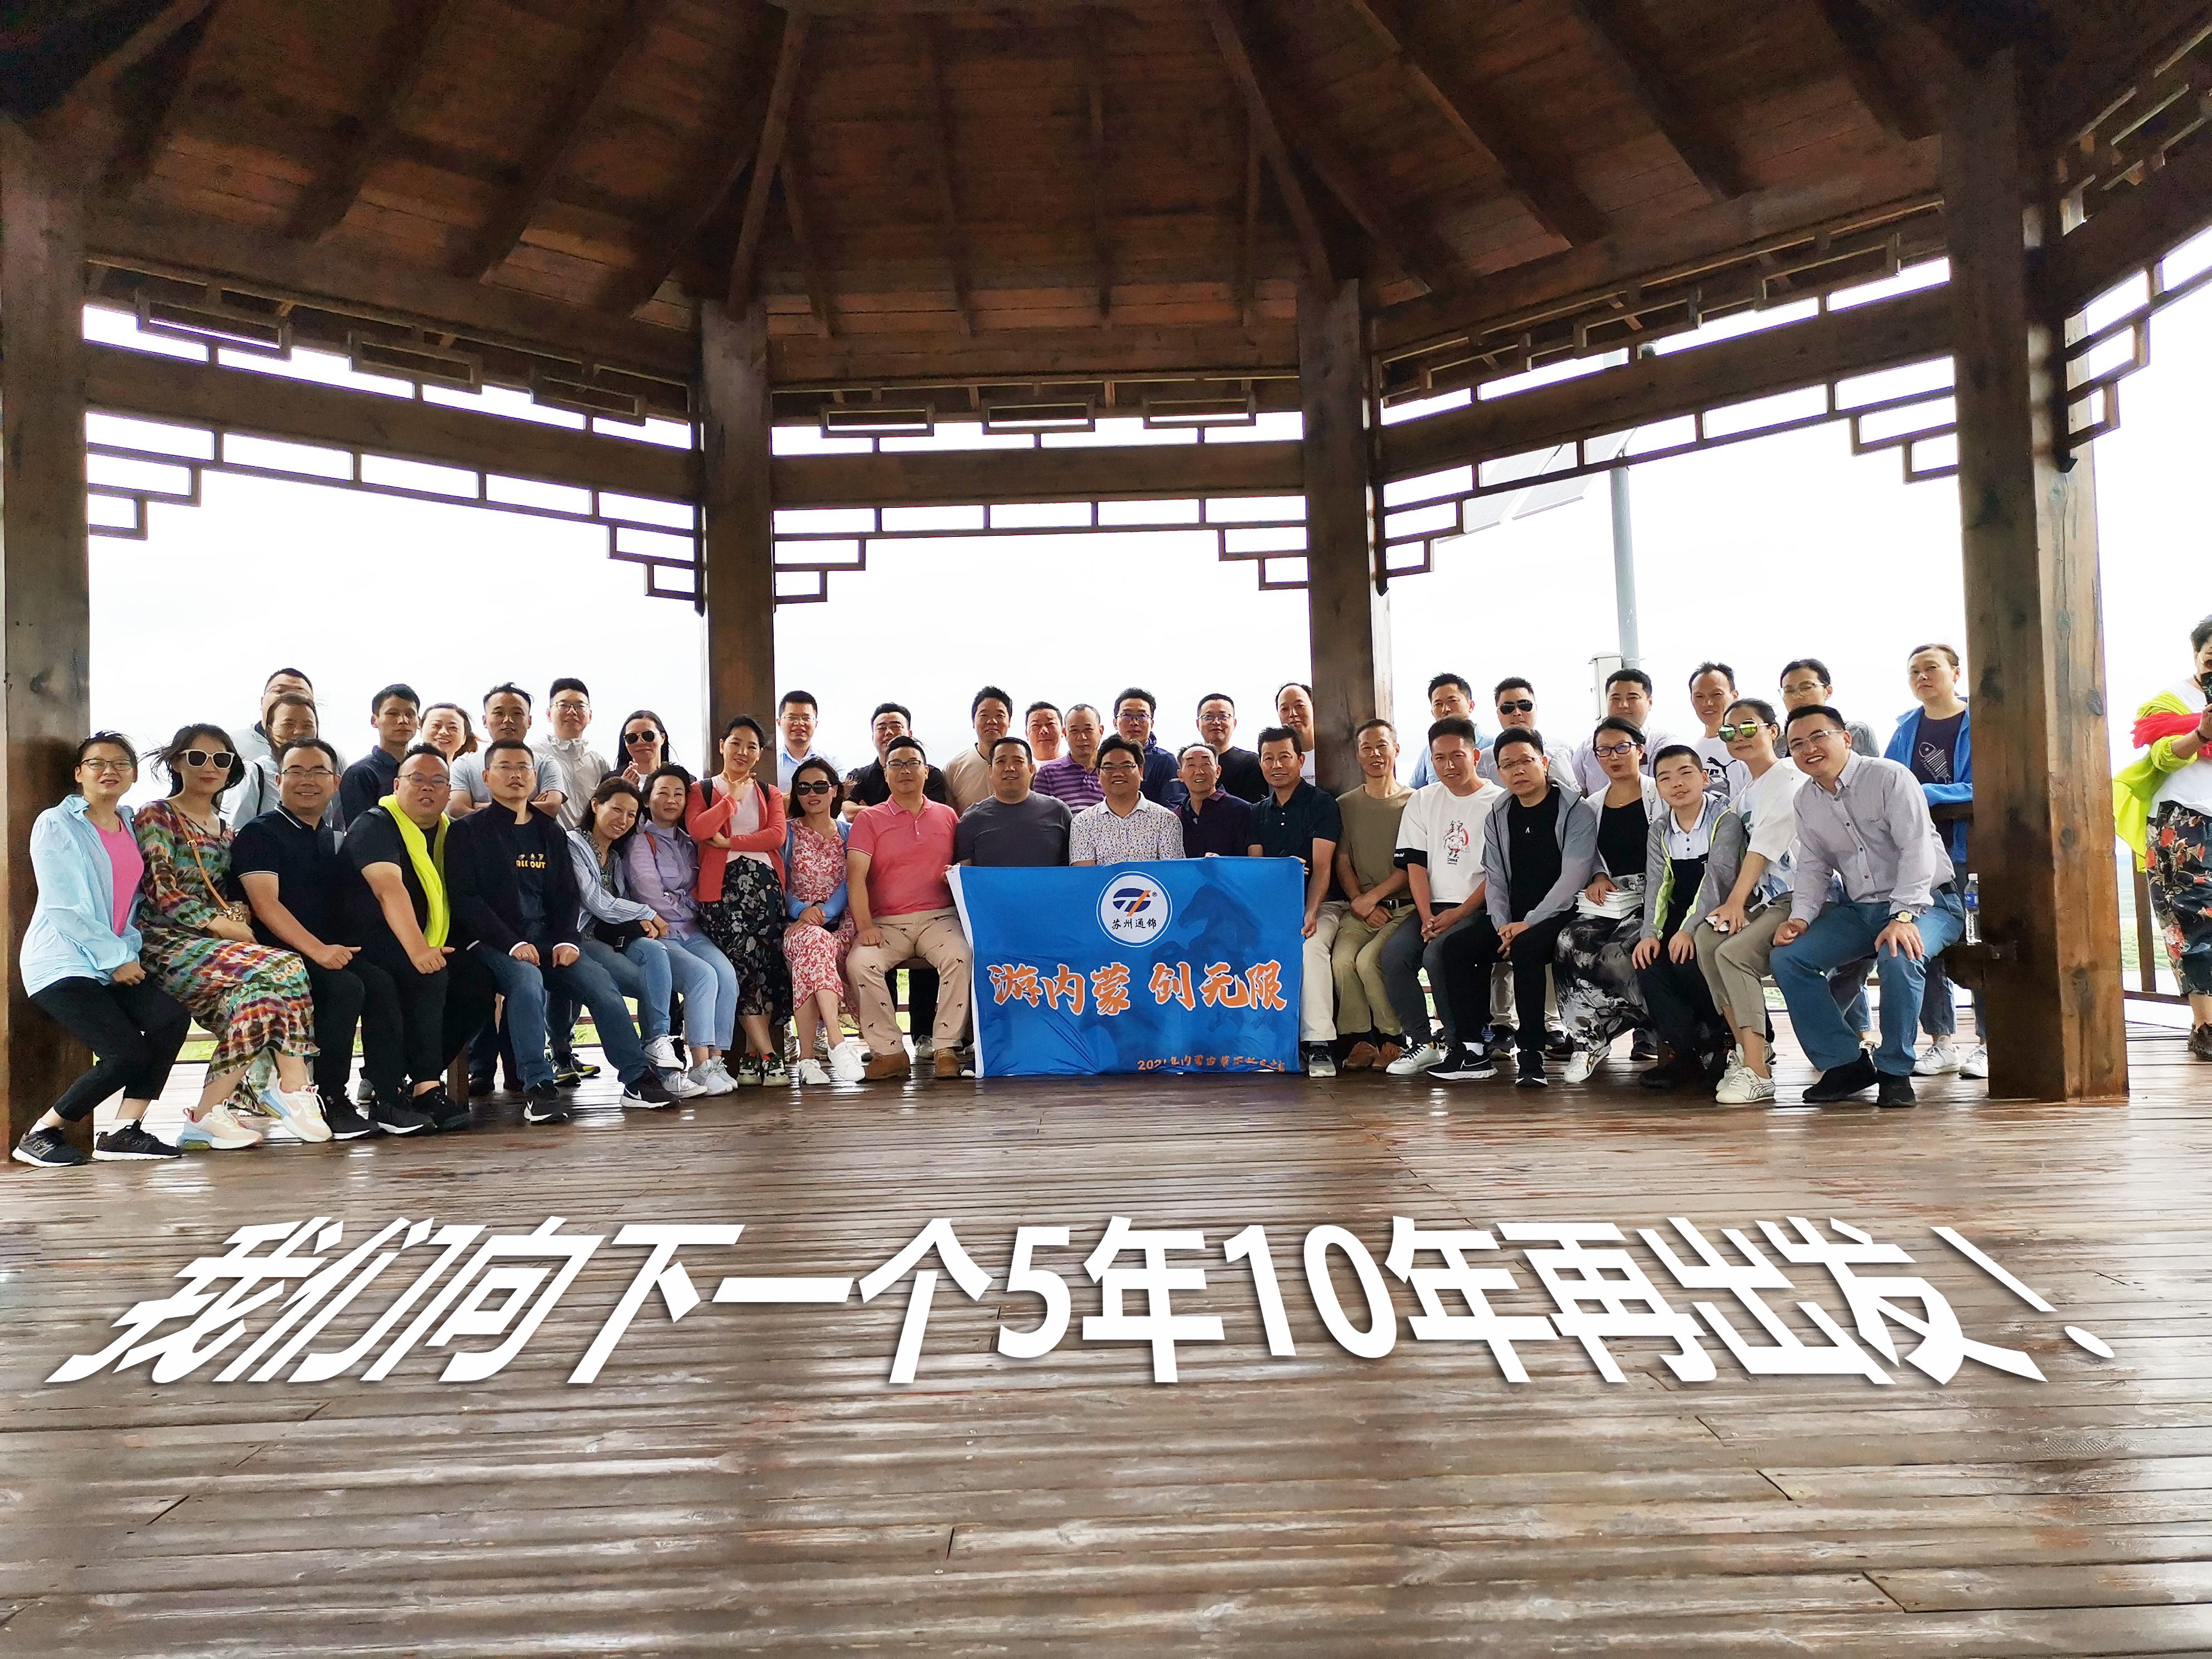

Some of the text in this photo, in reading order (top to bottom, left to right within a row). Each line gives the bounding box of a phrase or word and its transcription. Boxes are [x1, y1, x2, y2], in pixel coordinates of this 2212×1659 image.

[1112, 918, 1157, 930] 苏州通锦
[986, 959, 1288, 1016] 游内蒙 创无限
